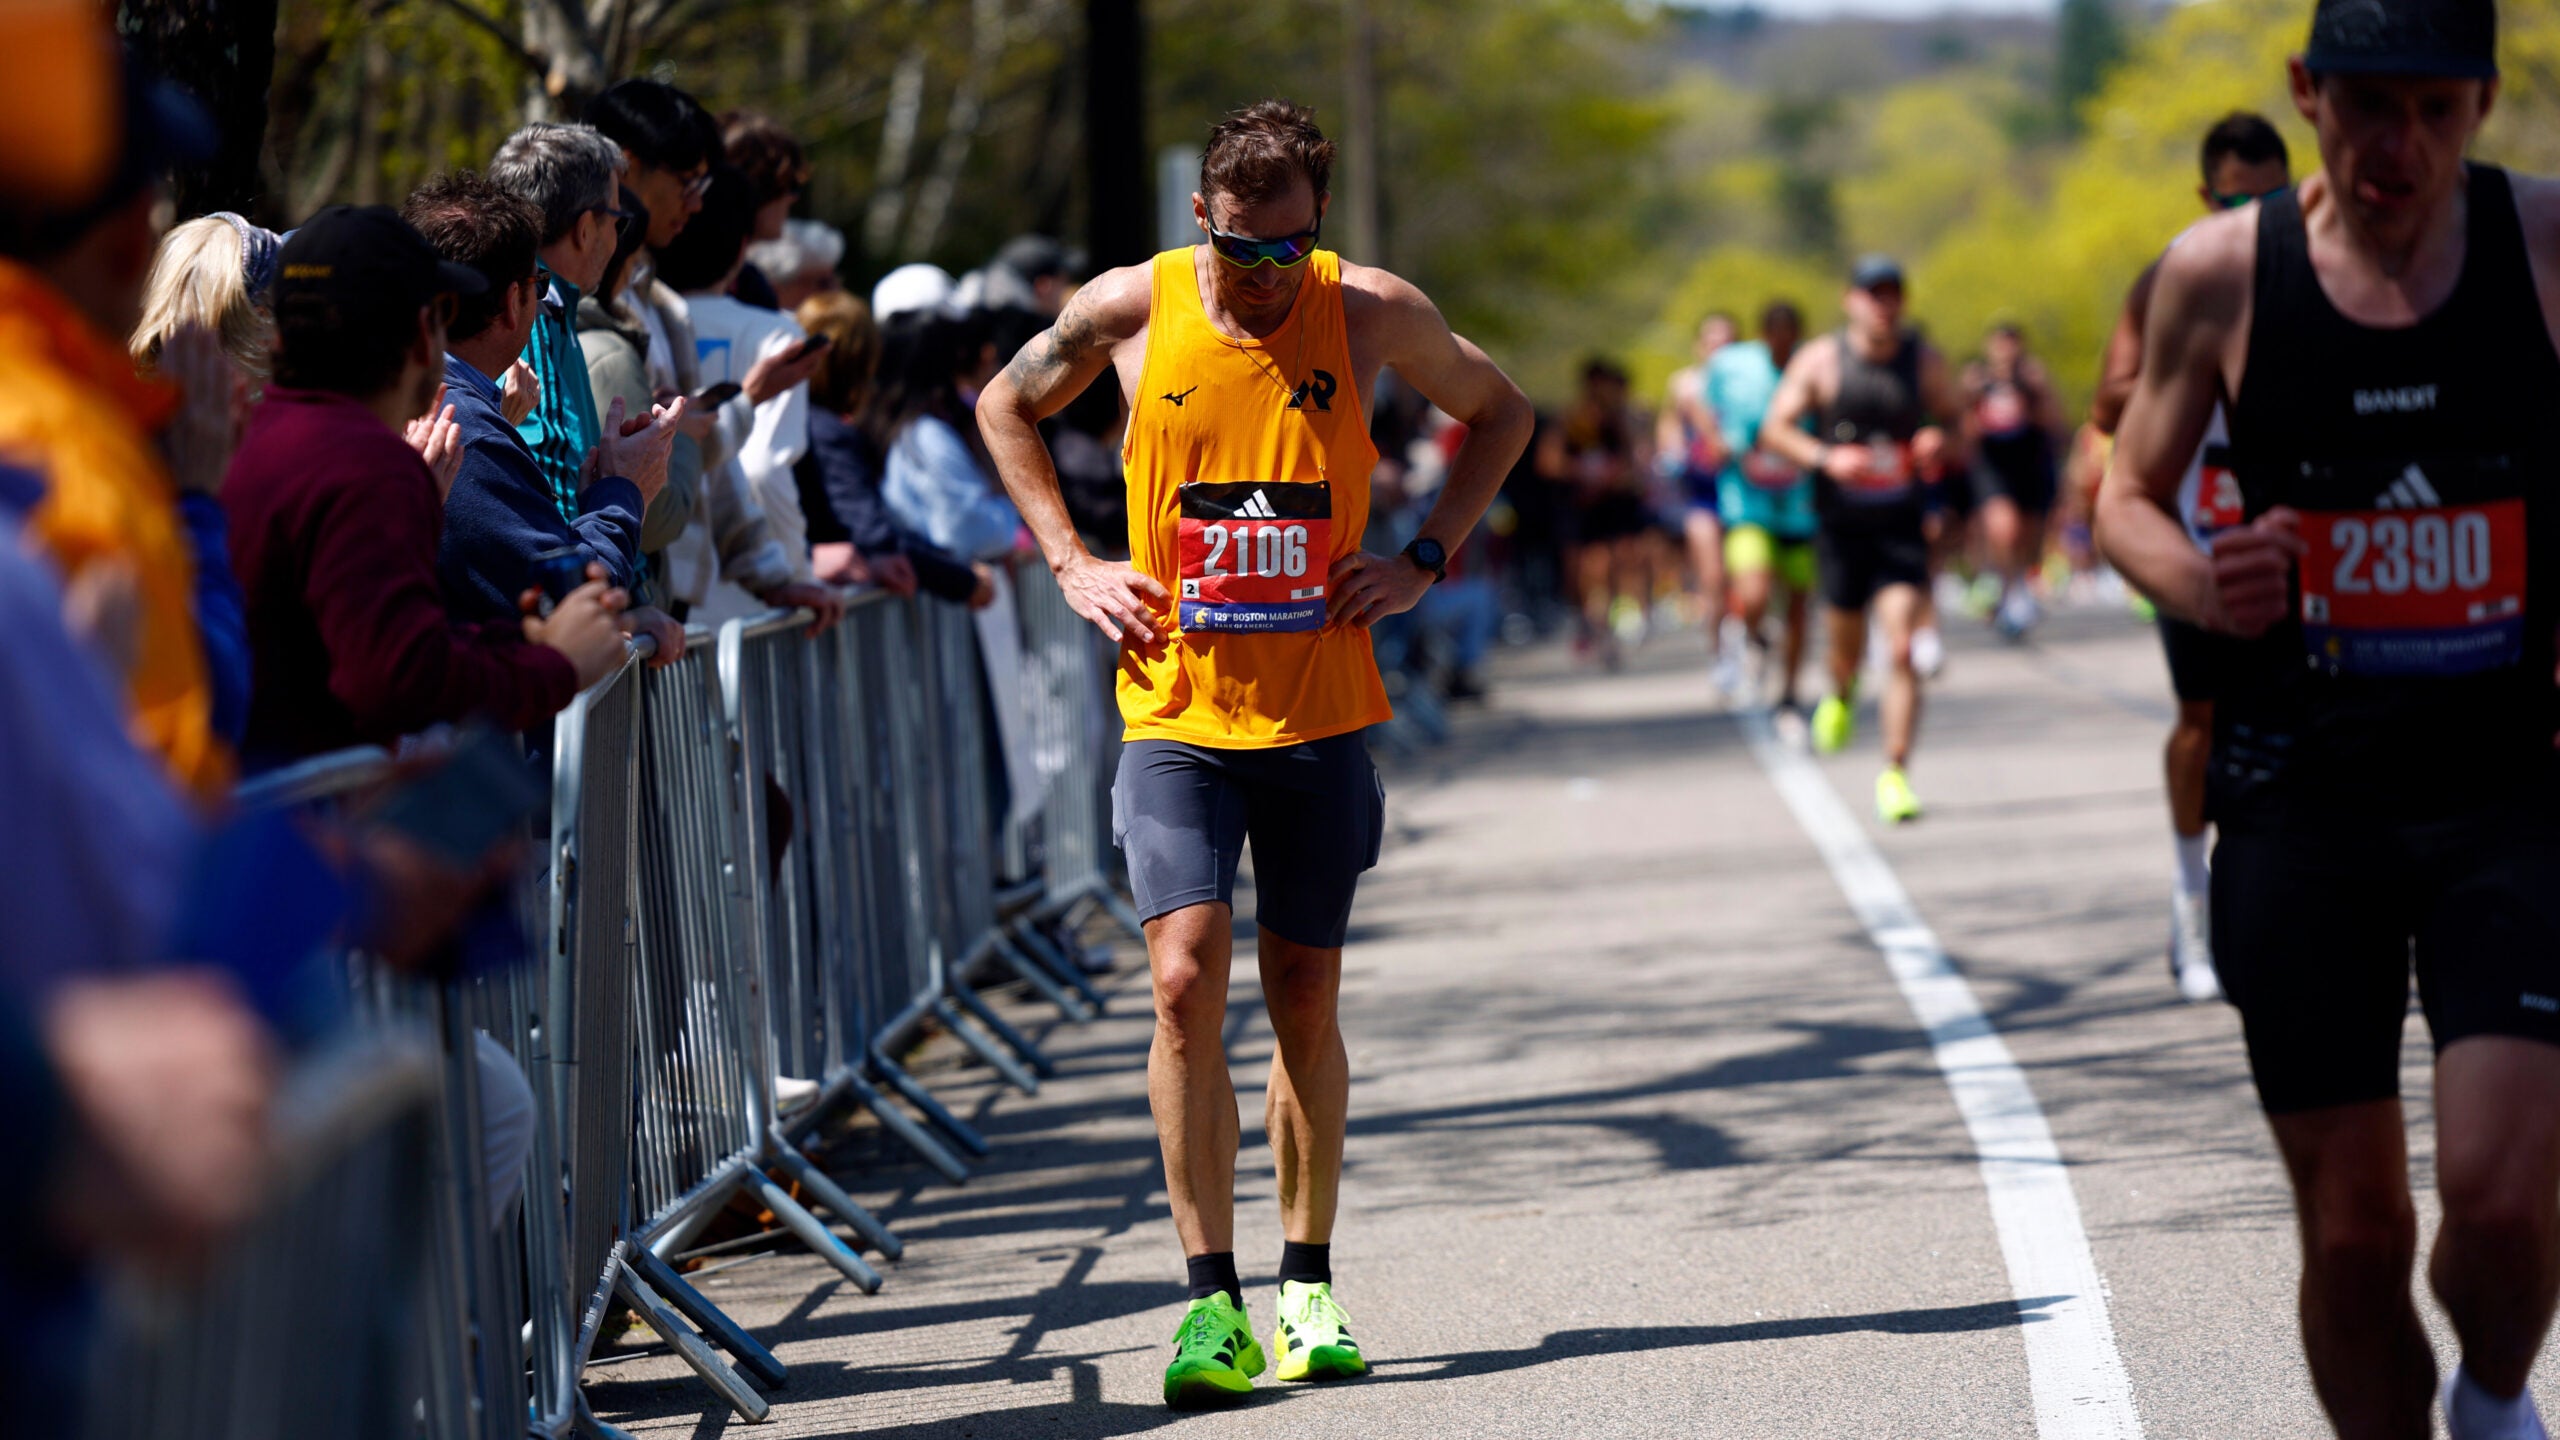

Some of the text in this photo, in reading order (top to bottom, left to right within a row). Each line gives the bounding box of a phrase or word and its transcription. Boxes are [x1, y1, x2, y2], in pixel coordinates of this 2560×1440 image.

[2353, 384, 2438, 415] BANDIT
[1203, 525, 1308, 578] 2106
[2330, 512, 2491, 596] 2390
[1186, 584, 1195, 594] 2
[1233, 613, 1267, 621] BOSTON
[1269, 609, 1314, 621] MARATHON
